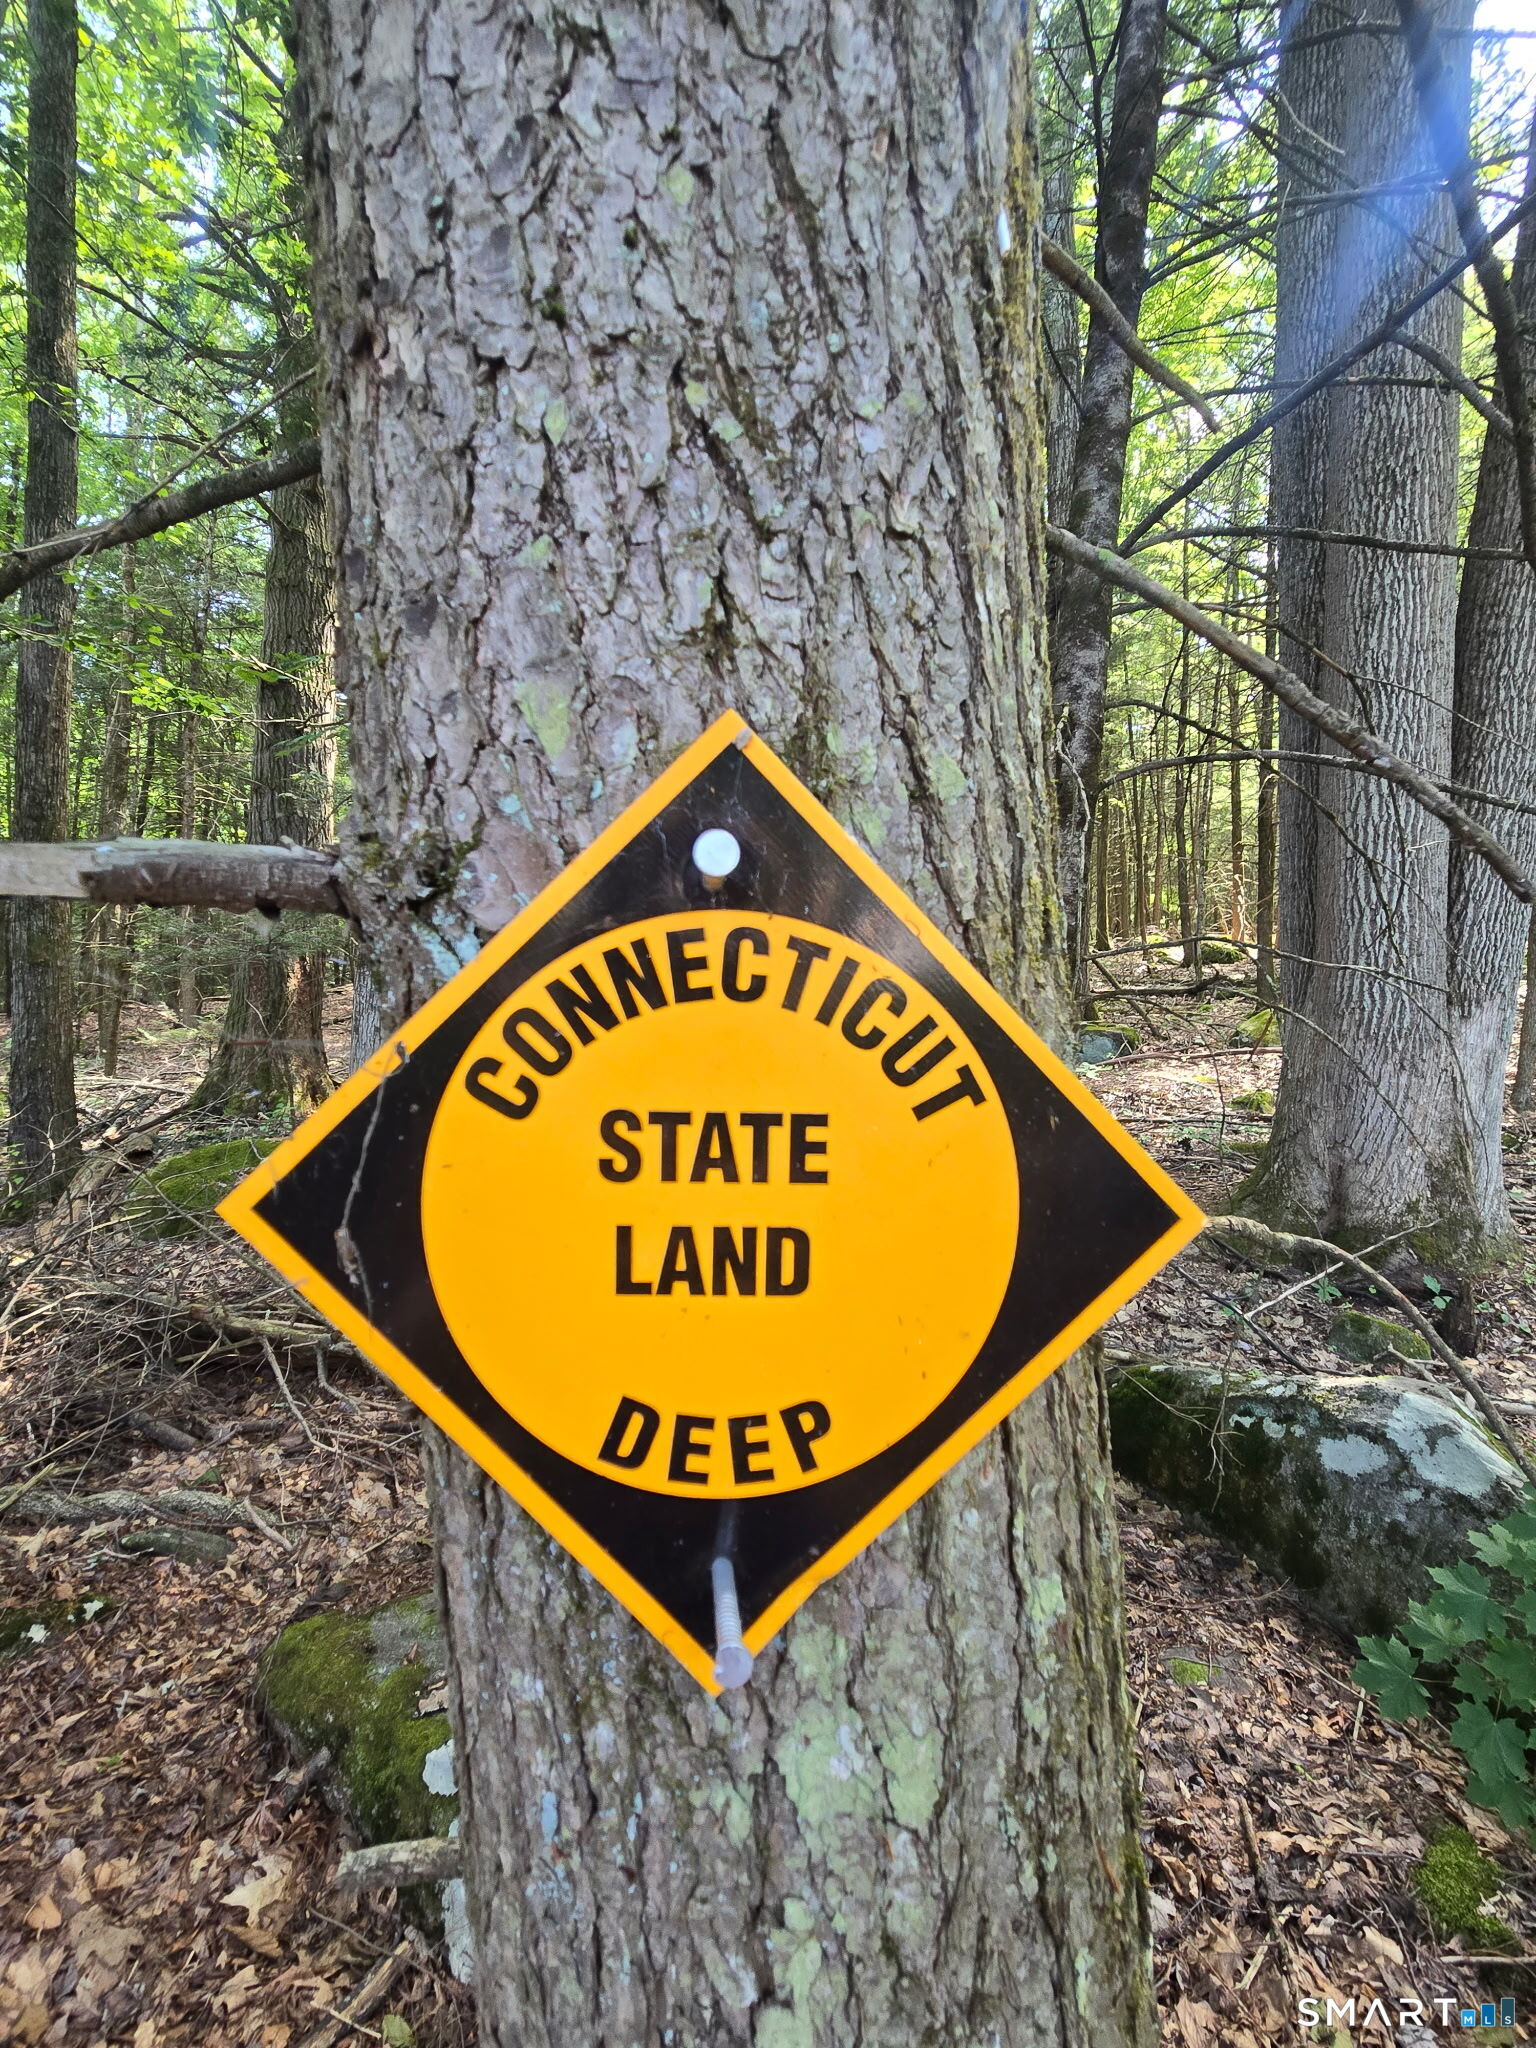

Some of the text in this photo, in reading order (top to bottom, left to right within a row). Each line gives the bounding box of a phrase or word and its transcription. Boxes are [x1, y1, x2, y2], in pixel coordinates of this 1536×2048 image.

[466, 927, 986, 1120] CONNECTICUT
[599, 1110, 829, 1183] STATE
[616, 1226, 810, 1296] LAND
[599, 1397, 831, 1485] DEEP
